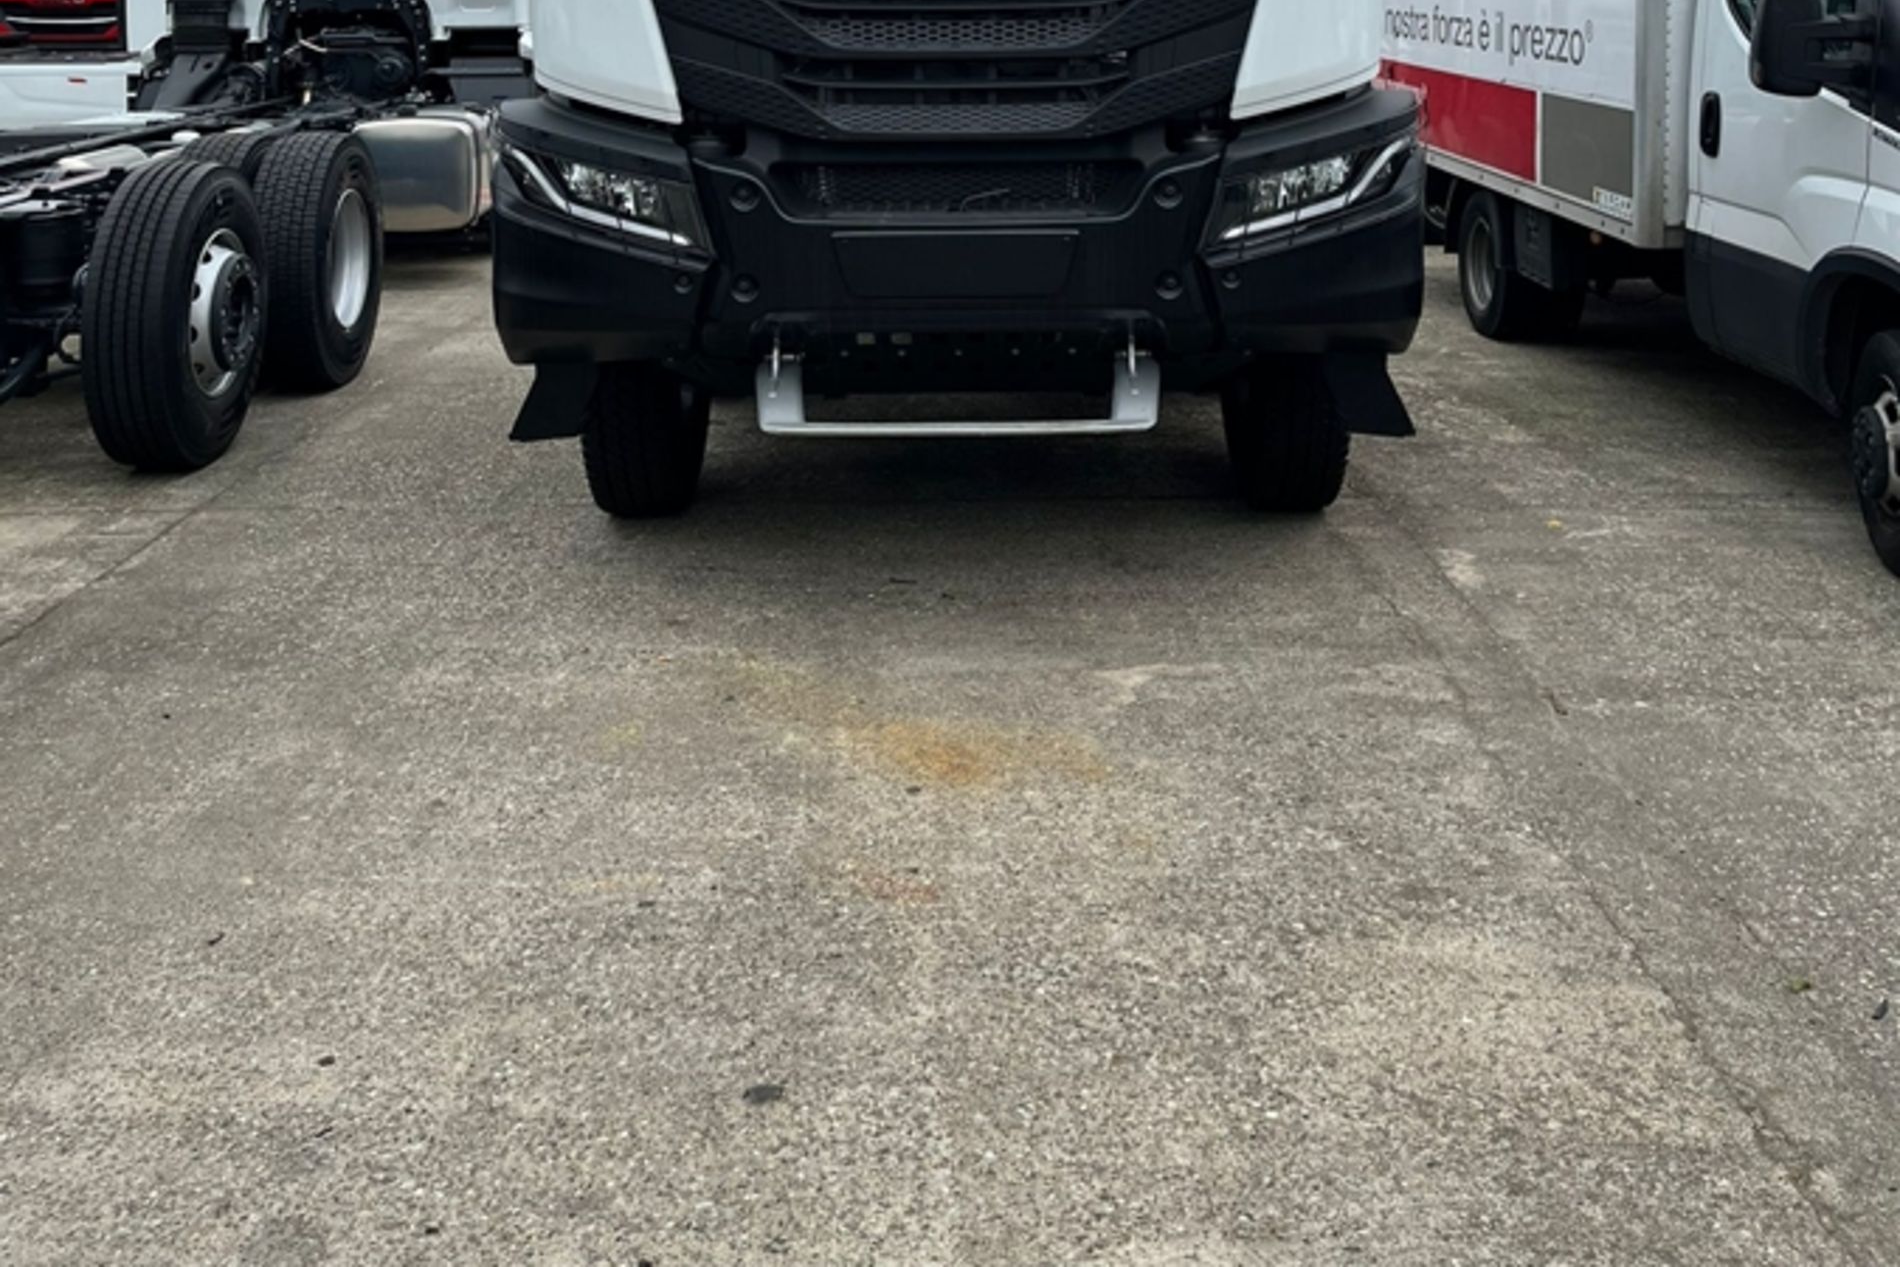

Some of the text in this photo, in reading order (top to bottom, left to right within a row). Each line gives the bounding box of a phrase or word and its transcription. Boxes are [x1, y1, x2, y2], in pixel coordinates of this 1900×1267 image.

[1432, 5, 1474, 49] forza
[1477, 9, 1490, 52] è
[1494, 11, 1505, 53] il
[1508, 21, 1586, 67] prezzo
